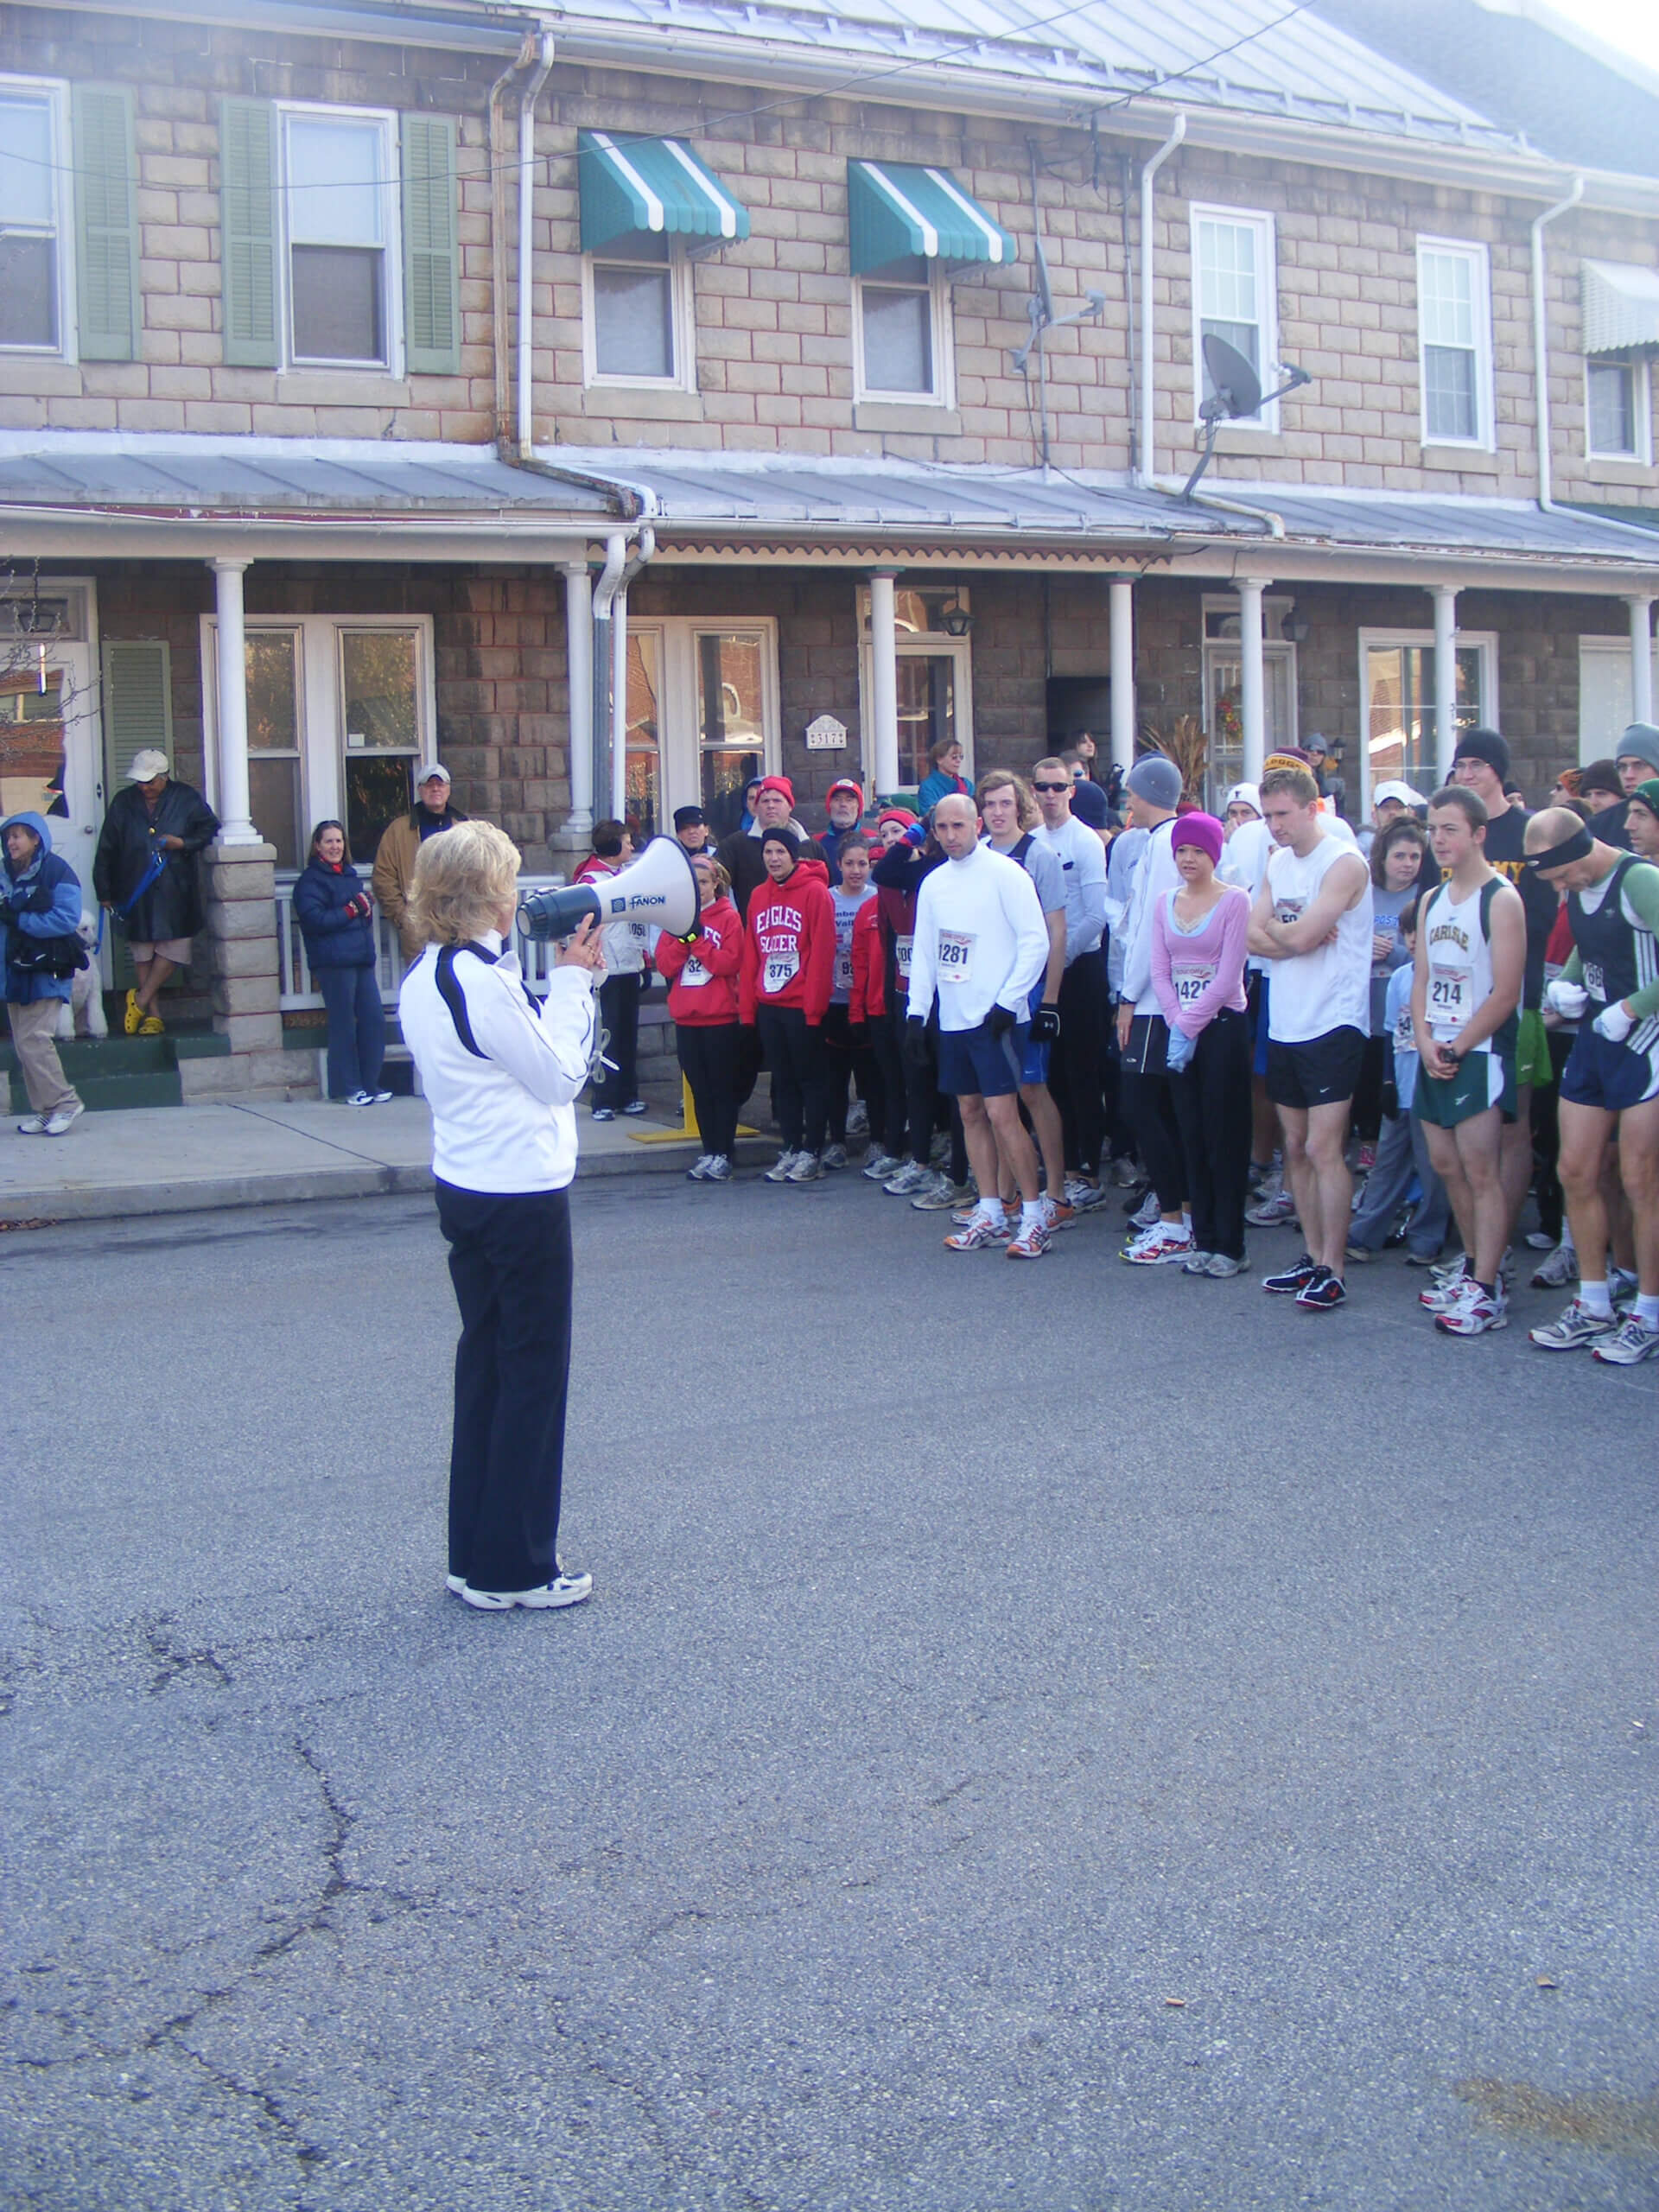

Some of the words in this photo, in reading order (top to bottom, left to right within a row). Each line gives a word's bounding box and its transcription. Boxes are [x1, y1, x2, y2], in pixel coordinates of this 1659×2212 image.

[629, 894, 666, 910] FANON
[760, 933, 798, 954] SOCER
[938, 944, 969, 965] 1281
[769, 963, 792, 978] 375
[1432, 981, 1462, 1005] 214
